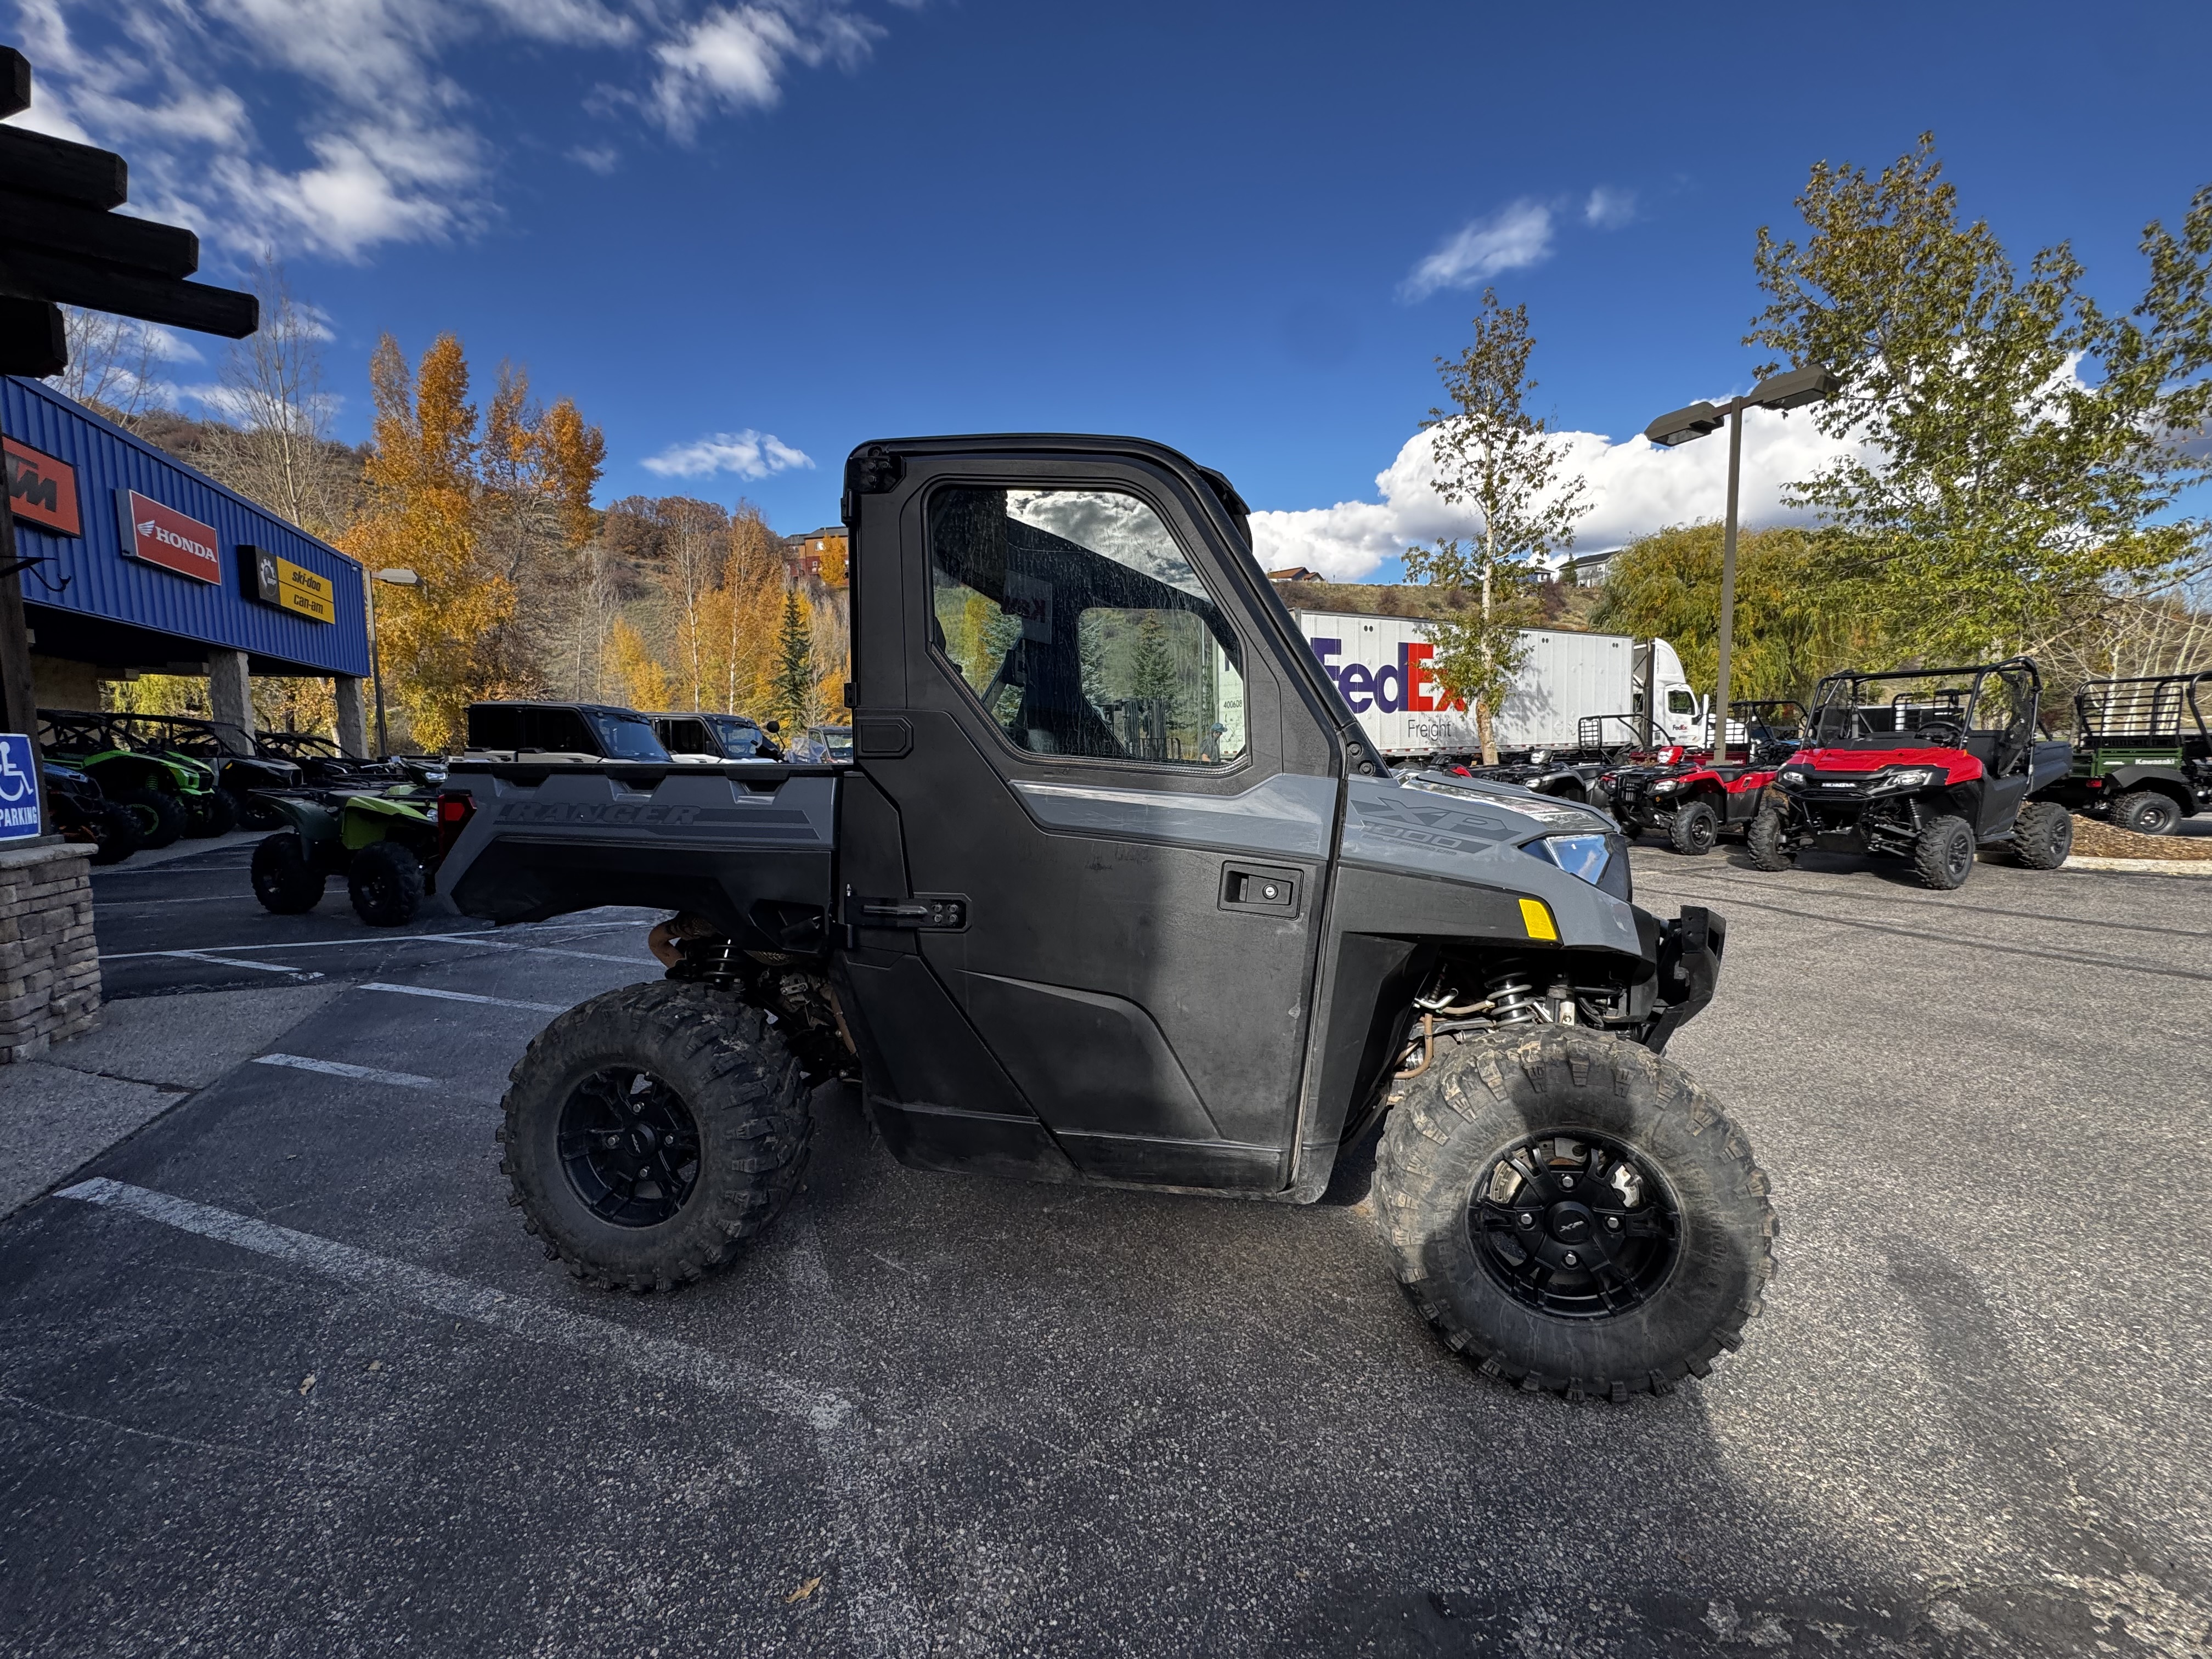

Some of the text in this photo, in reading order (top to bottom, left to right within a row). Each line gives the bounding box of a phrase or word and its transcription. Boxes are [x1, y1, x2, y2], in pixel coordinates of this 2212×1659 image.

[5, 450, 57, 512] TM
[155, 526, 217, 563] HONDA
[292, 571, 321, 591] ski-doo
[294, 594, 324, 614] can-am
[1311, 637, 1466, 714] FedEx
[1223, 699, 1243, 709] 400608
[1408, 719, 1452, 741] Freight
[0, 806, 37, 827] PARKING
[503, 802, 702, 825] RANGER
[1356, 797, 1508, 832] XP
[1559, 1221, 1584, 1232] XP
